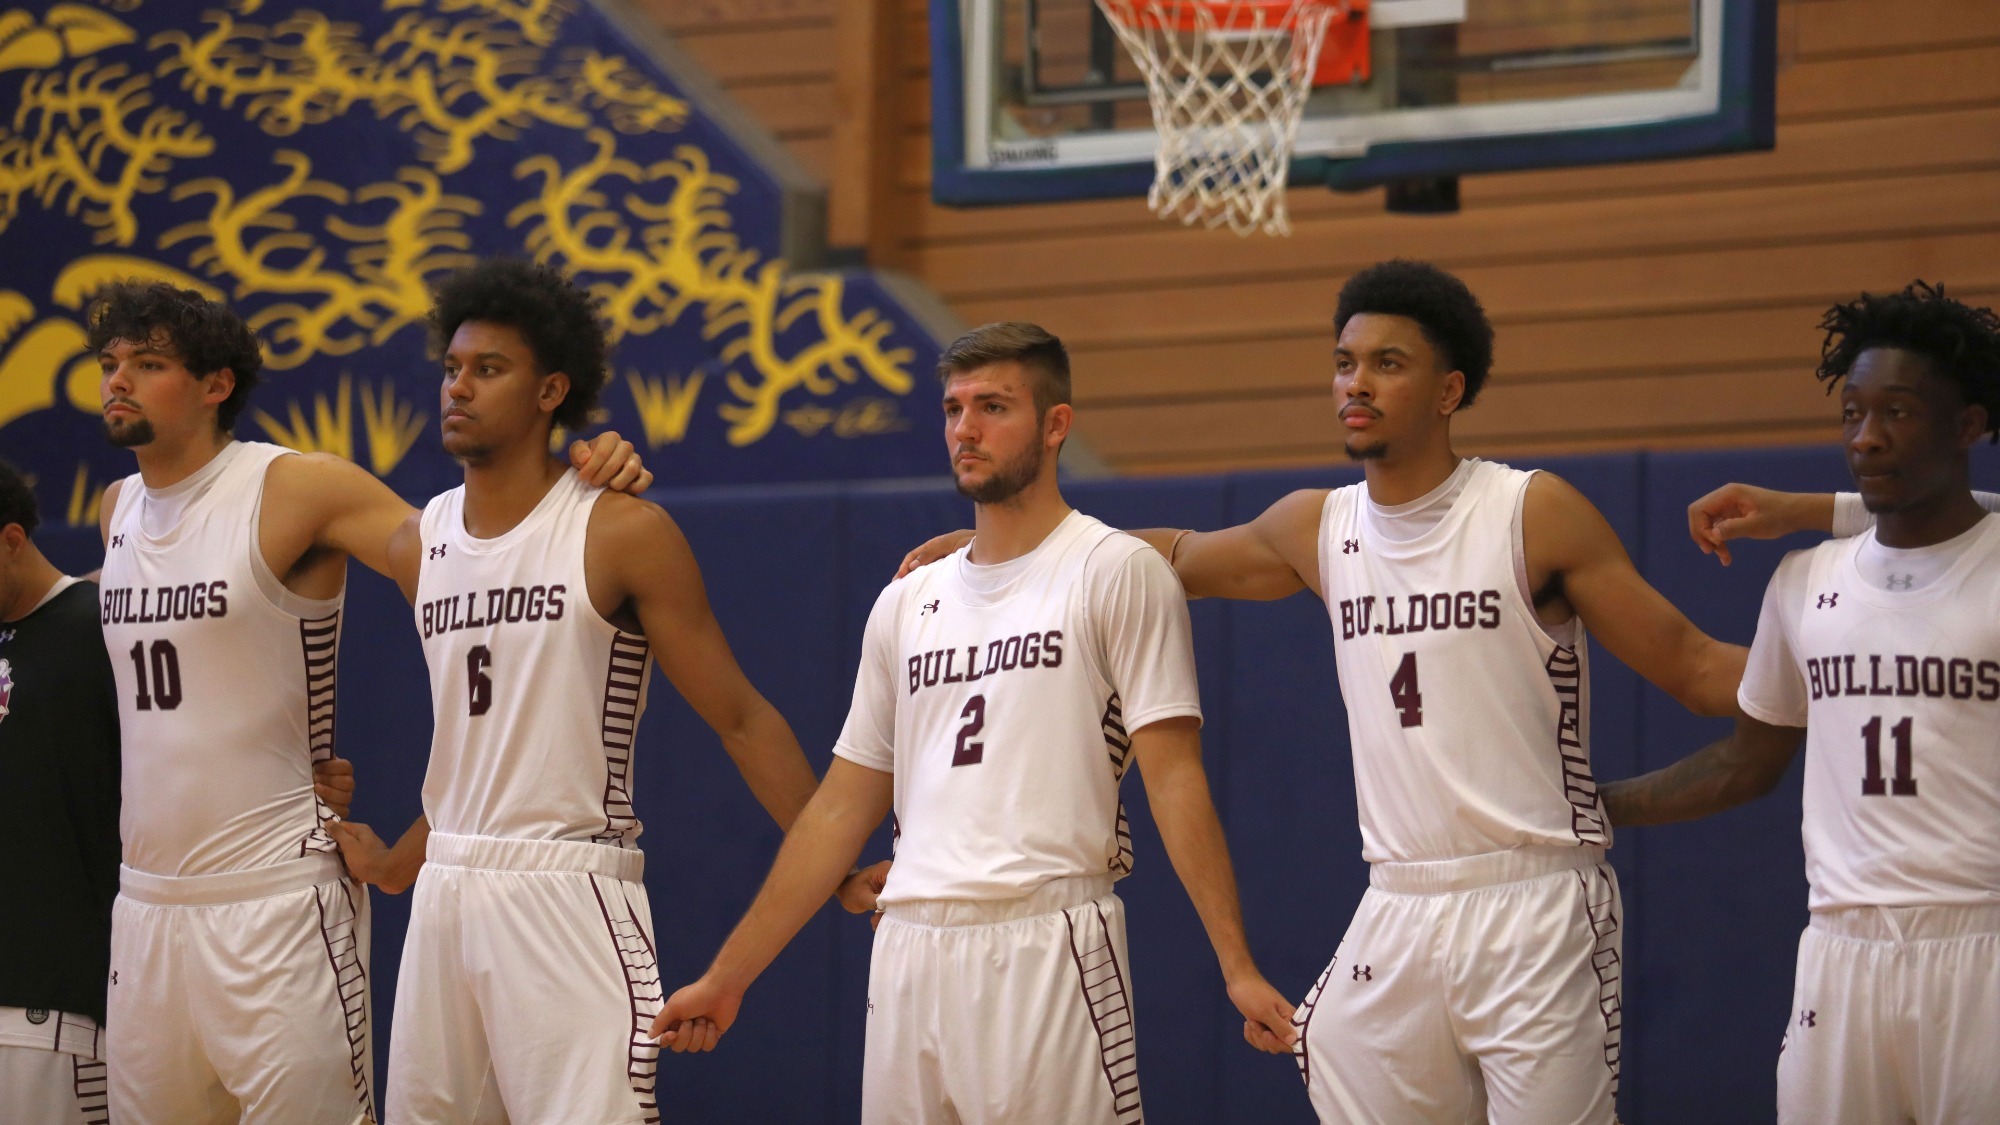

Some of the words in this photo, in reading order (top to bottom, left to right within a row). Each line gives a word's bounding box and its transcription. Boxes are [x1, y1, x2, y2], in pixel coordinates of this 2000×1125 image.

[102, 580, 228, 625] BULLDOGS
[422, 584, 567, 640] BULLDOGS
[130, 638, 183, 712] 10
[467, 644, 492, 717] 6
[908, 630, 1063, 696] BULLDOGS
[1389, 651, 1423, 729] 4
[1806, 654, 2000, 701] BULLDOGS
[951, 694, 986, 768] 2
[1861, 715, 1918, 797] 11
